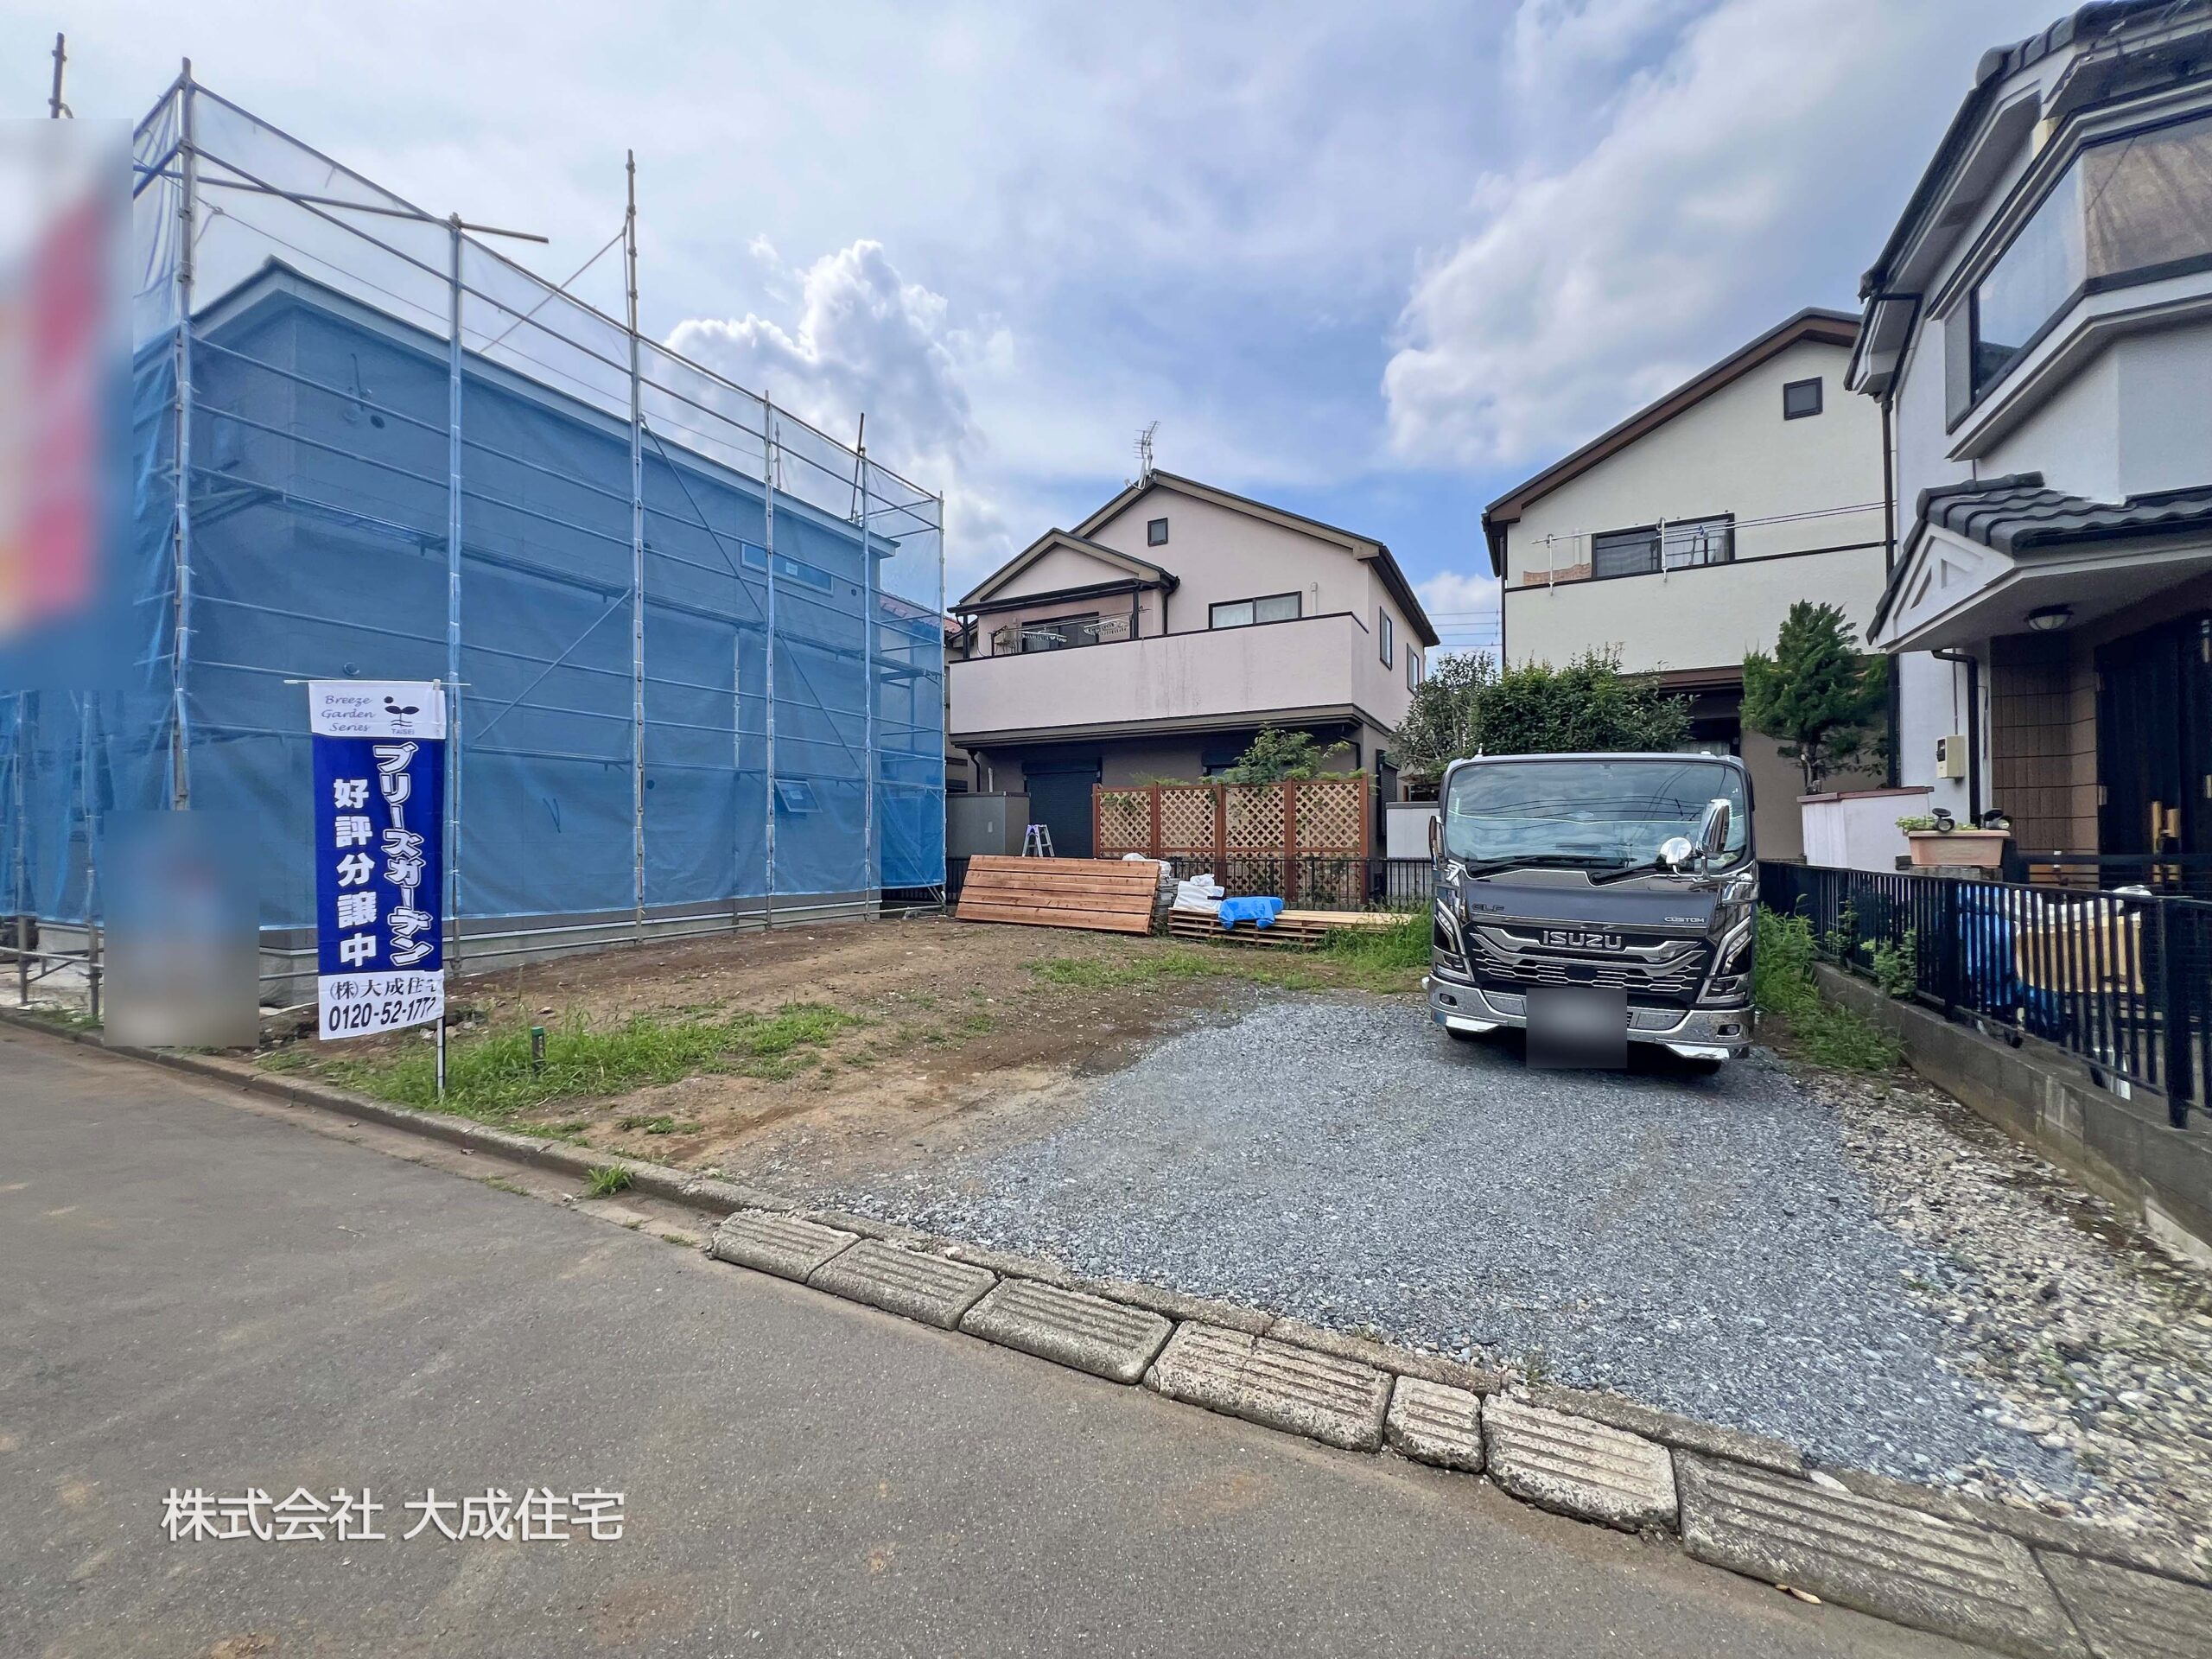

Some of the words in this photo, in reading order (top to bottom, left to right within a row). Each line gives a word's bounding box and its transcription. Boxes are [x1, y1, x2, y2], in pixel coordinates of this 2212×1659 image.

[325, 695, 373, 707] Breeze
[321, 709, 377, 719] Garden
[329, 722, 372, 732] Series
[372, 741, 435, 968] ブリーズガーデン
[334, 778, 378, 968] 好評分譲中
[1542, 930, 1622, 950] ISUZU
